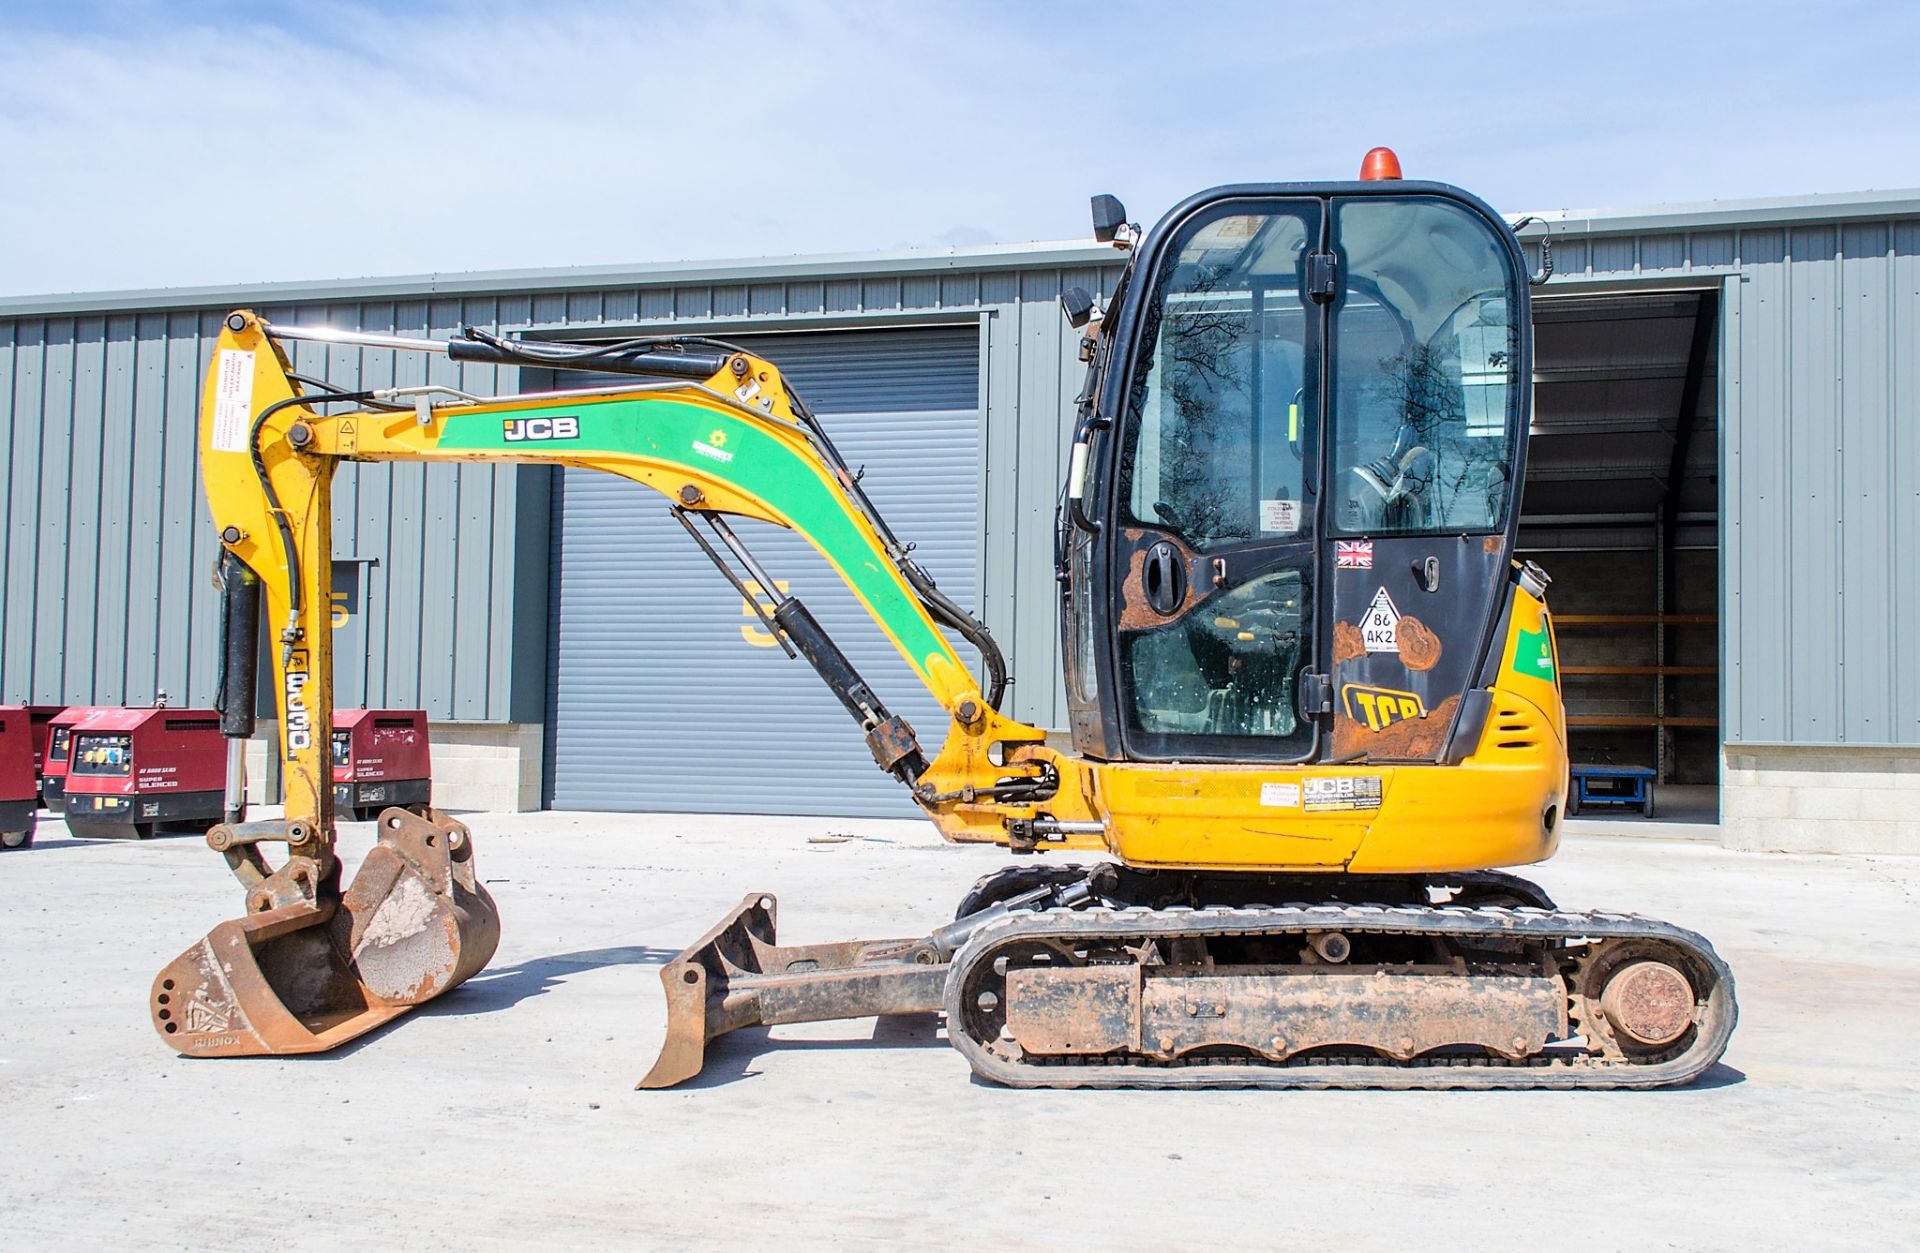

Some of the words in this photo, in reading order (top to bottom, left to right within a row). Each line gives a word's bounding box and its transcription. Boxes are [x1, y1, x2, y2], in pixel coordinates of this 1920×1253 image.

[505, 417, 578, 441] JCB
[741, 580, 789, 647] 5
[1374, 613, 1391, 627] 86
[1367, 630, 1397, 643] AK2
[138, 781, 178, 789] SILENCED
[1304, 779, 1354, 794] JCB
